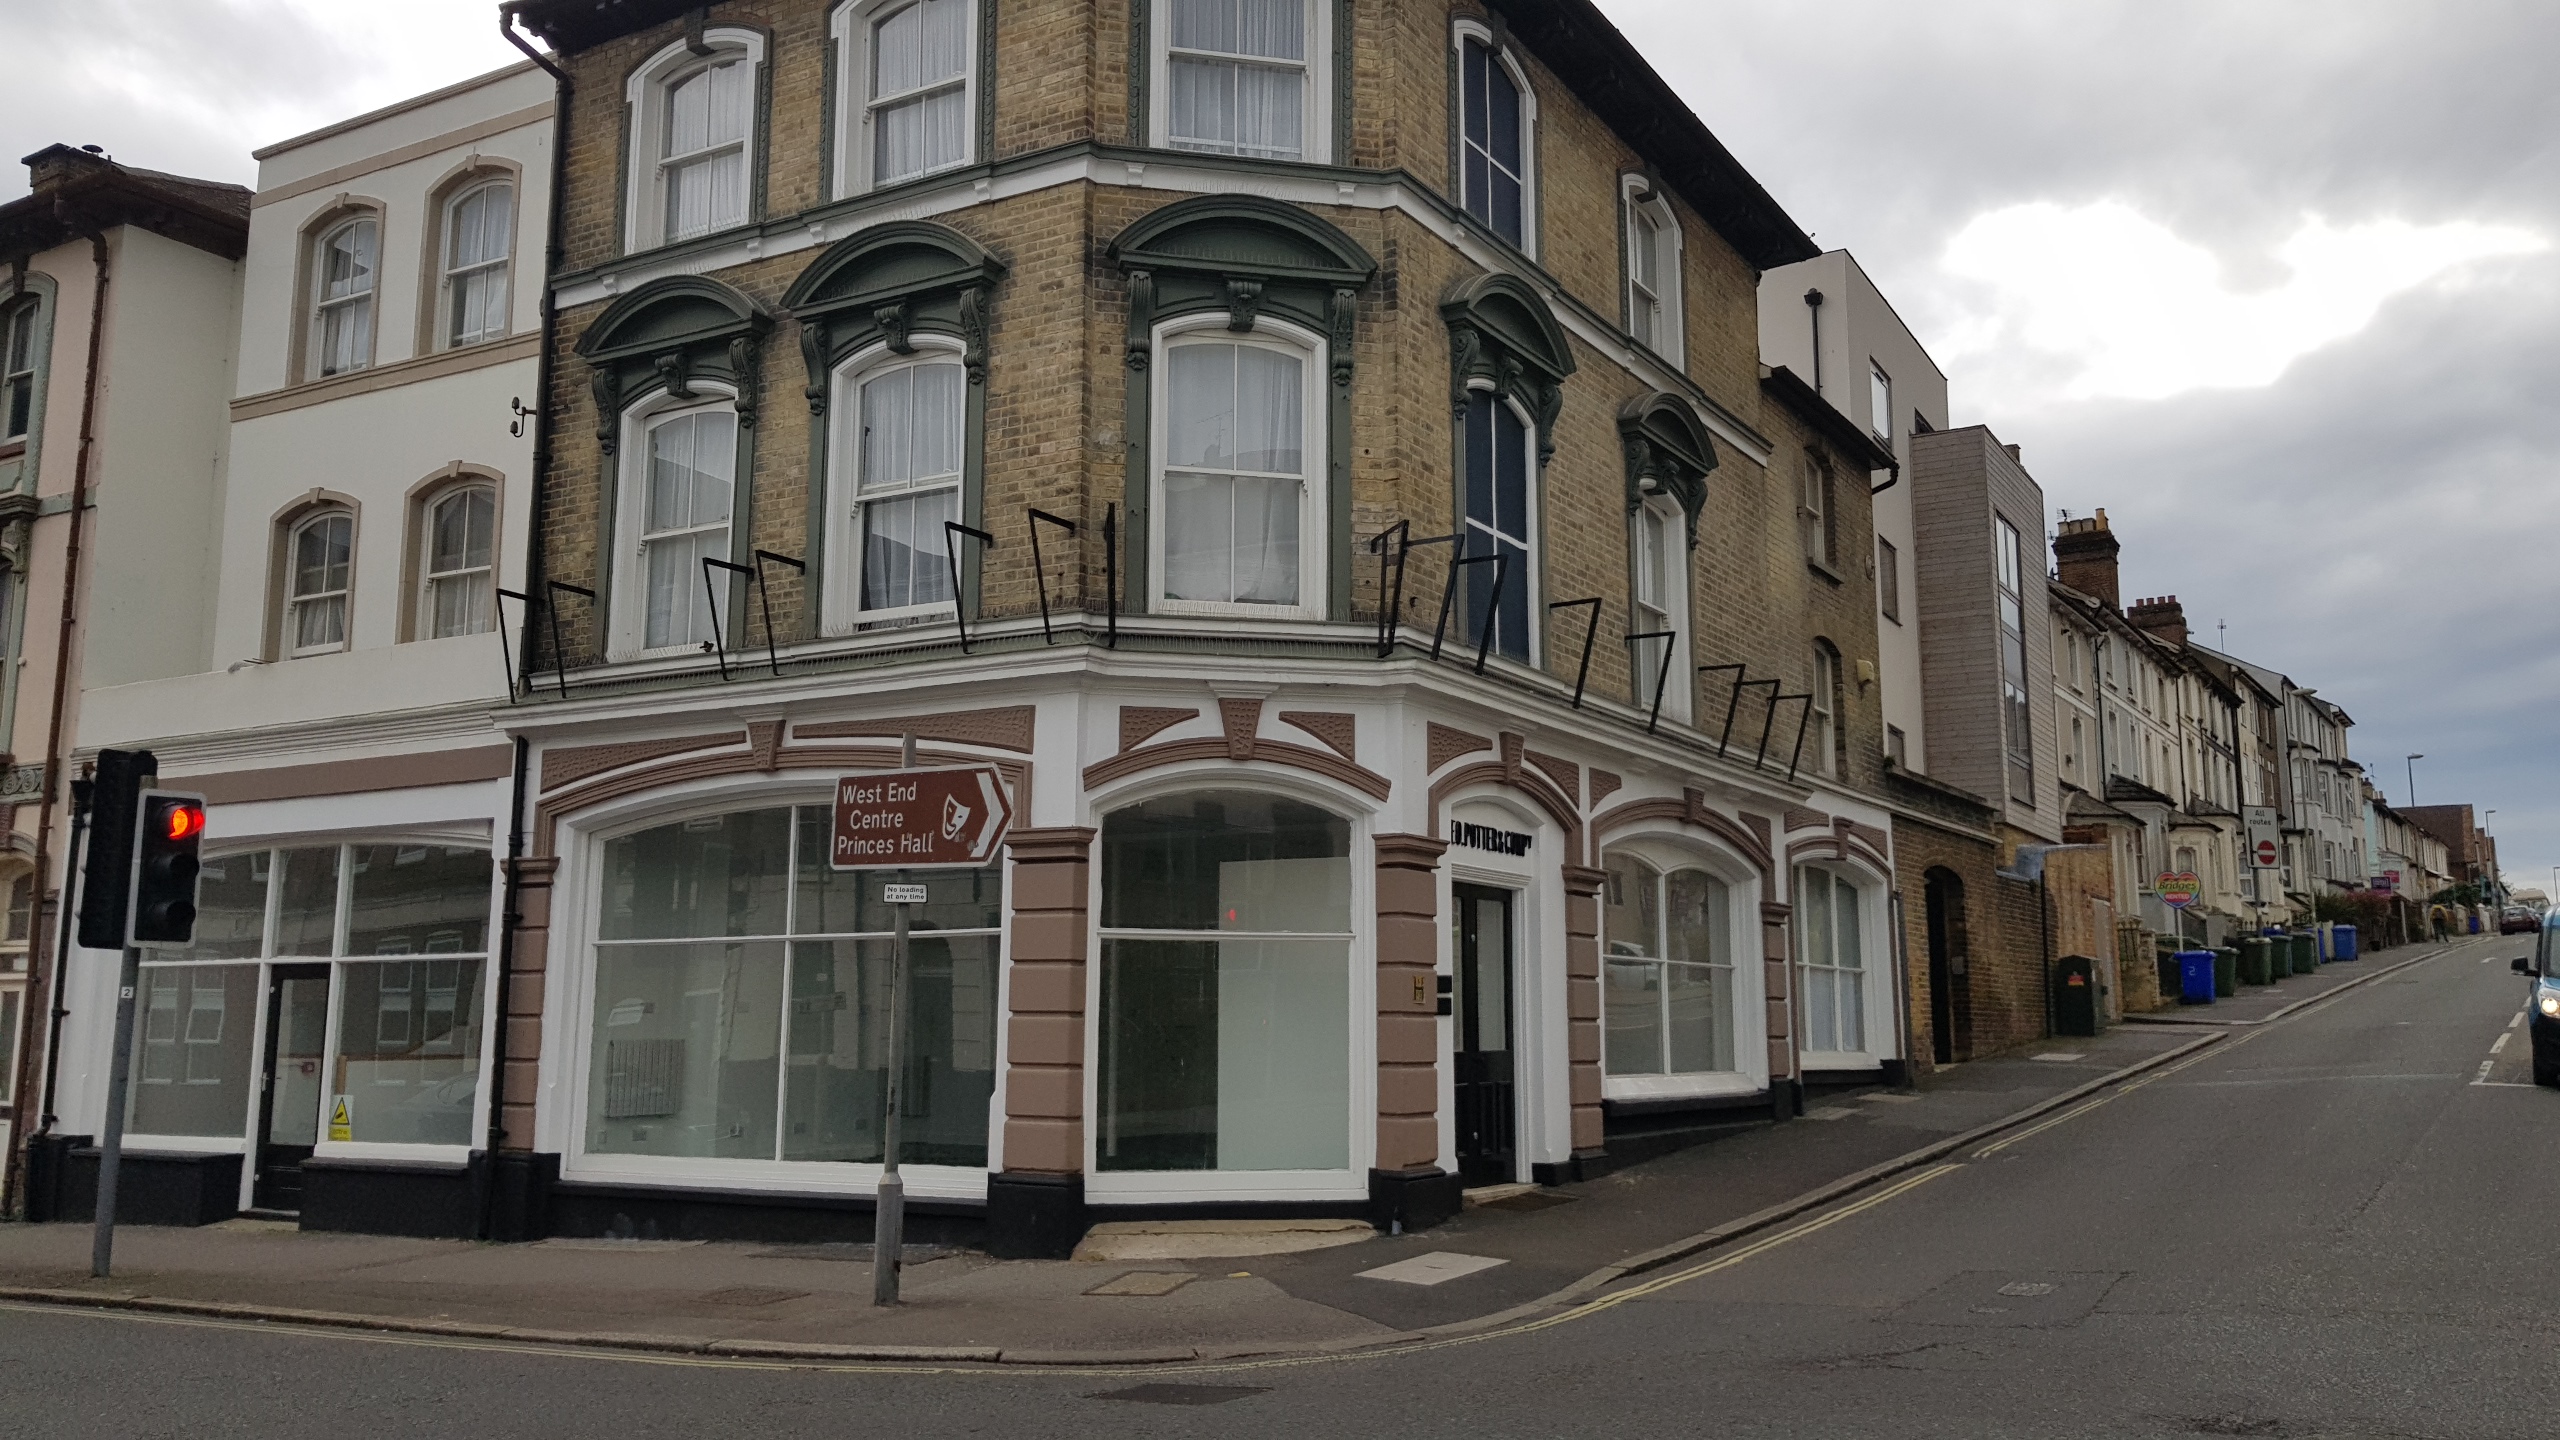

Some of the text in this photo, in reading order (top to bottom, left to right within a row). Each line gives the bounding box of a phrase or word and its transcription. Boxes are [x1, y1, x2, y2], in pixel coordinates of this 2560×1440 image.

[843, 782, 917, 804] West End
[850, 809, 904, 830] Centre
[2250, 818, 2271, 826] routes
[838, 834, 933, 855] Princes Hall
[2159, 881, 2196, 890] Bridges
[124, 988, 131, 997] 2
